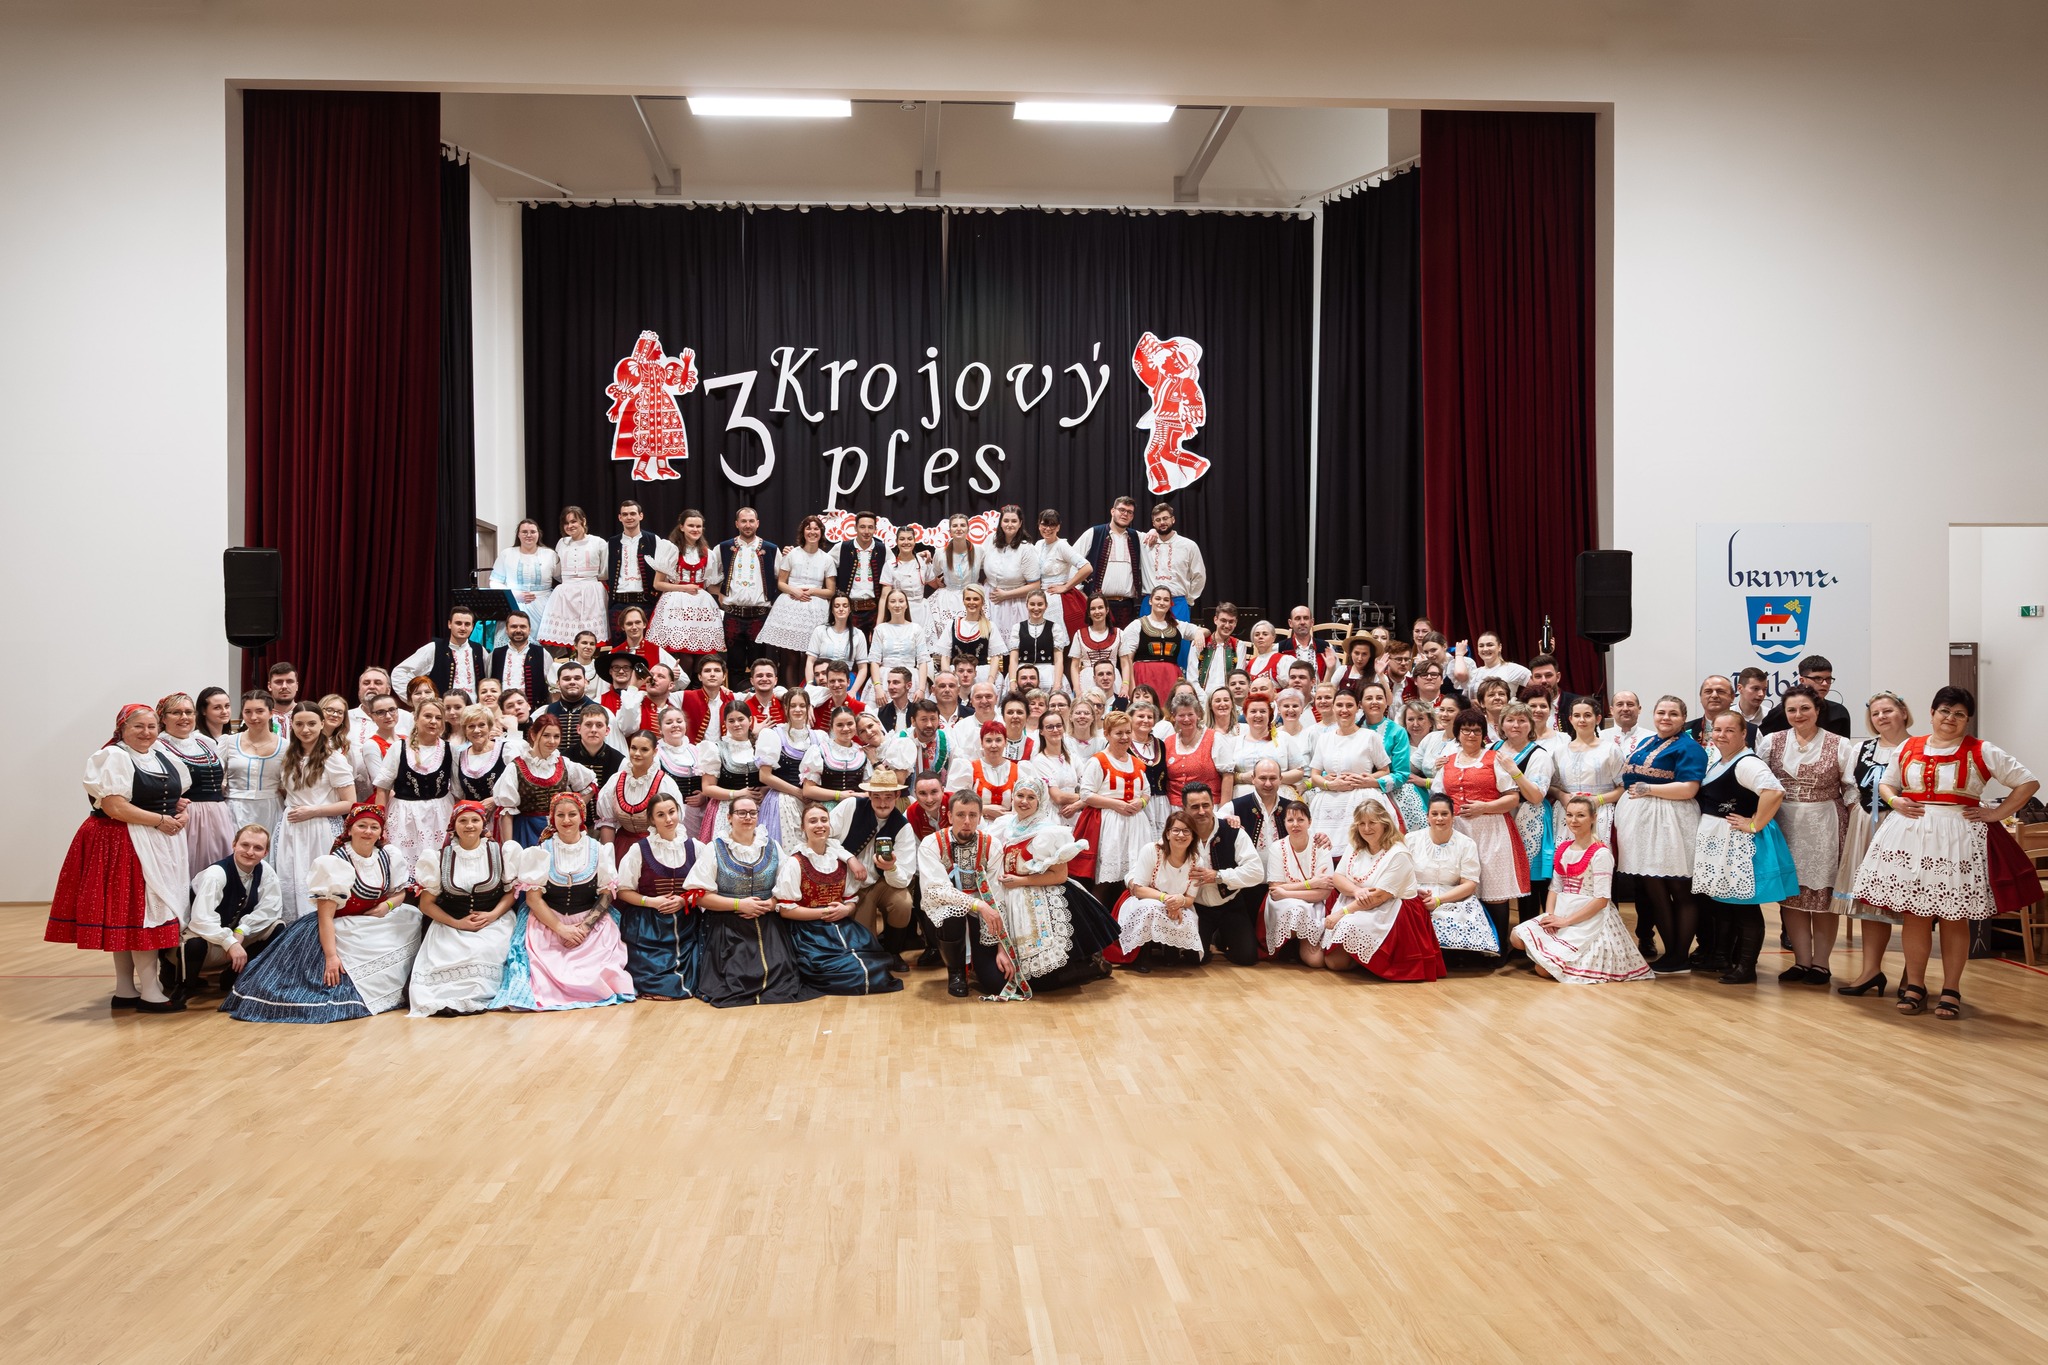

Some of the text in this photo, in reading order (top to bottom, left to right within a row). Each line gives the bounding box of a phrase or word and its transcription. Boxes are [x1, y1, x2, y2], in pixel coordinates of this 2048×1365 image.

[703, 342, 1111, 488] 3 Krojový
[822, 429, 1006, 513] ples
